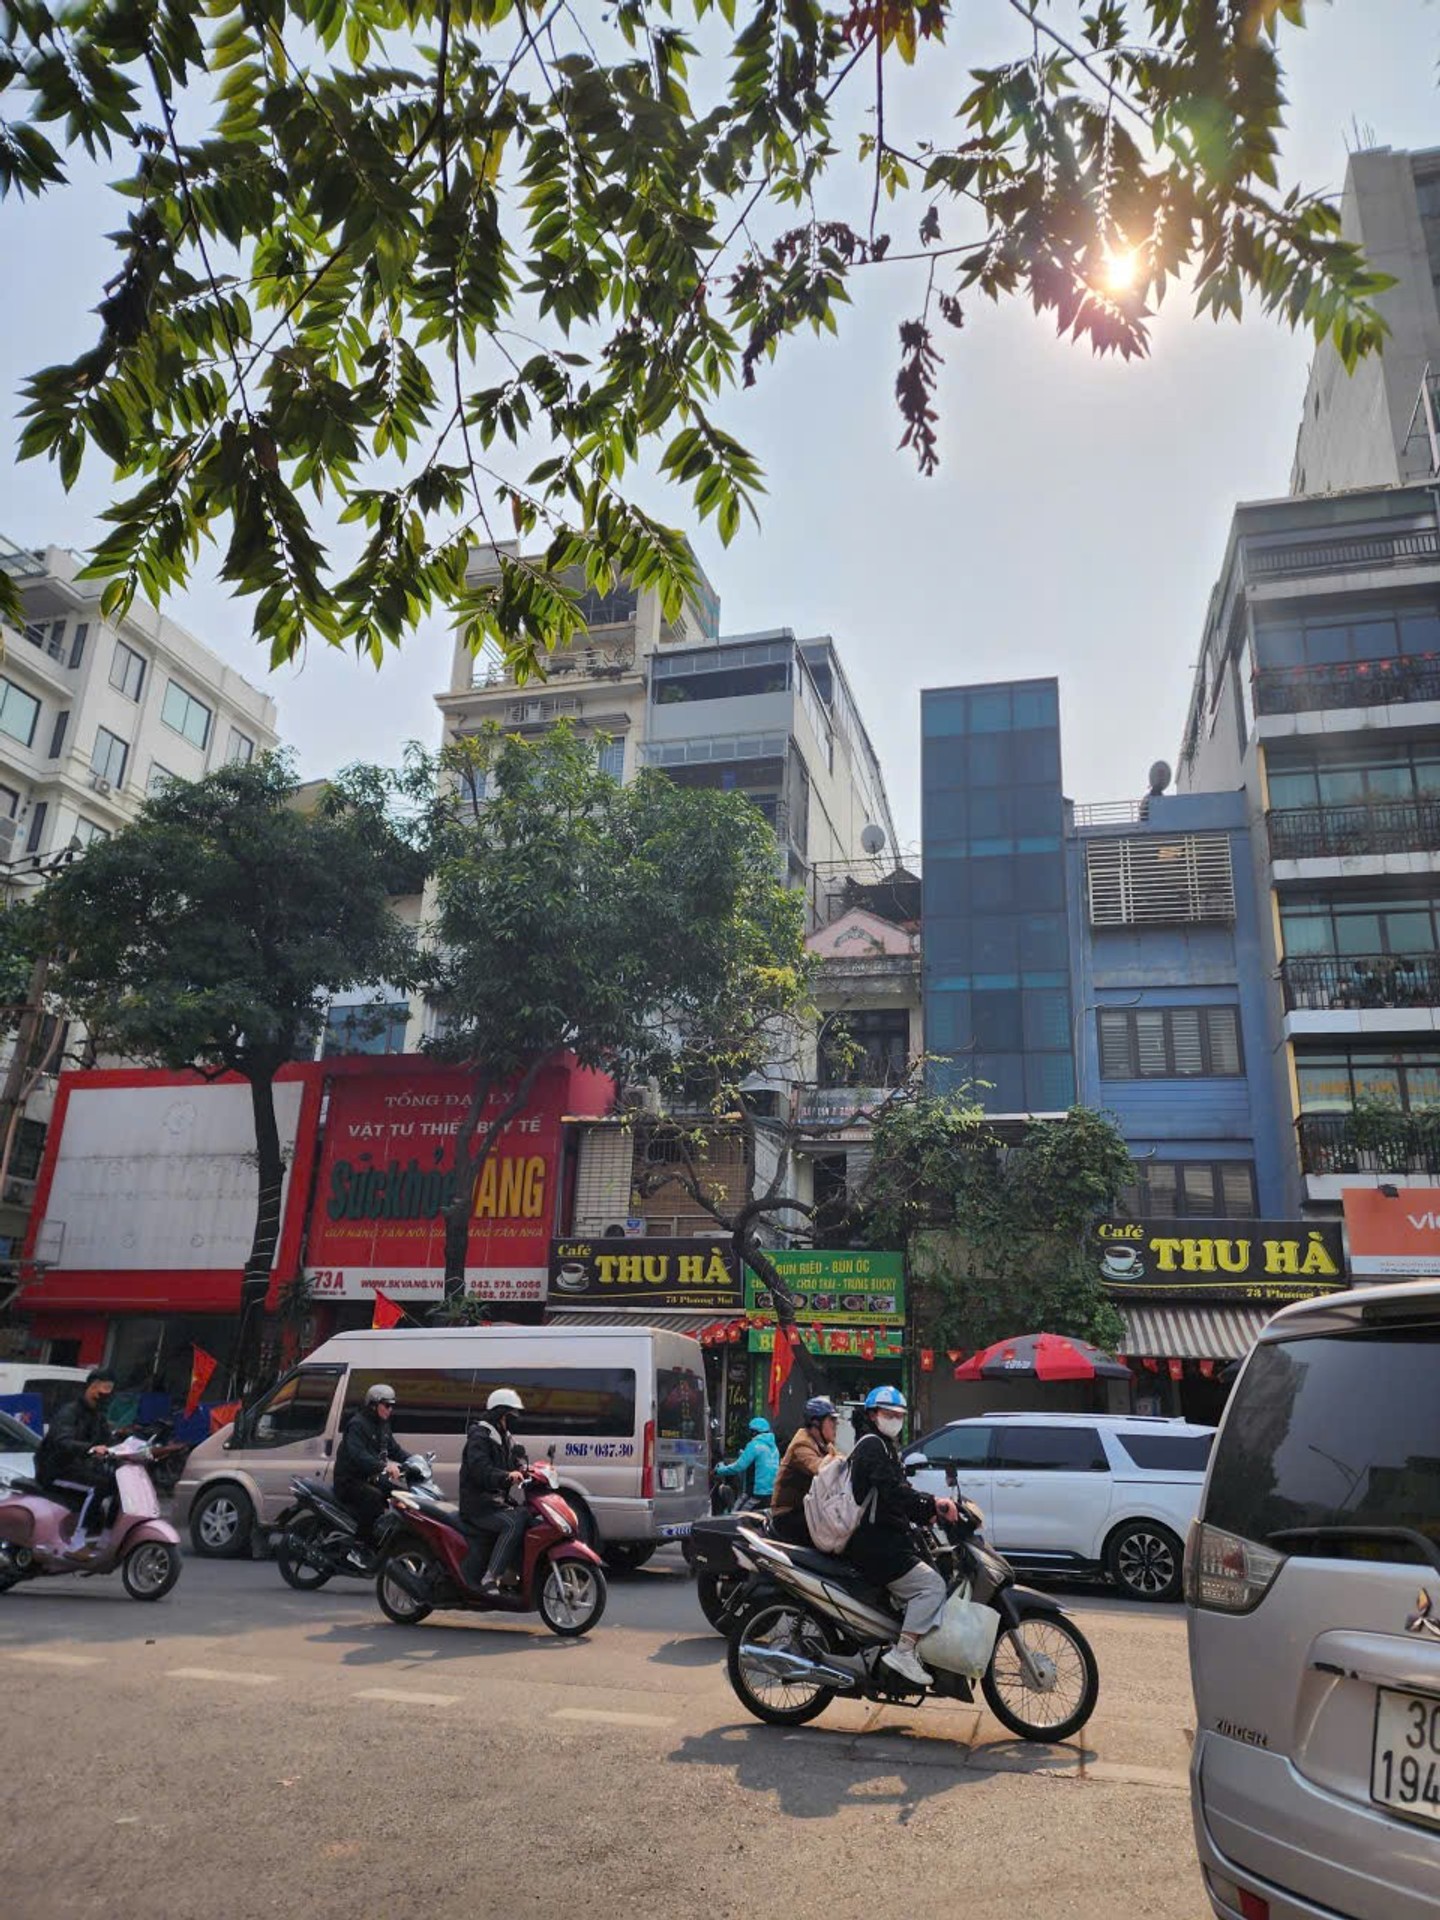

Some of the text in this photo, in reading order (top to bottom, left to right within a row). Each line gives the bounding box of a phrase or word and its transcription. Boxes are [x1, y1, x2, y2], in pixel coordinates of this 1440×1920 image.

[444, 1094, 475, 1108] ĐẠ
[348, 1120, 385, 1140] VẬT
[420, 1116, 463, 1136] THIẾ
[519, 1113, 544, 1133] TẾ
[1098, 1223, 1145, 1239] Café
[557, 1243, 592, 1257] Café
[1150, 1231, 1341, 1276] THU HÀ
[594, 1247, 733, 1285] THU HÀ
